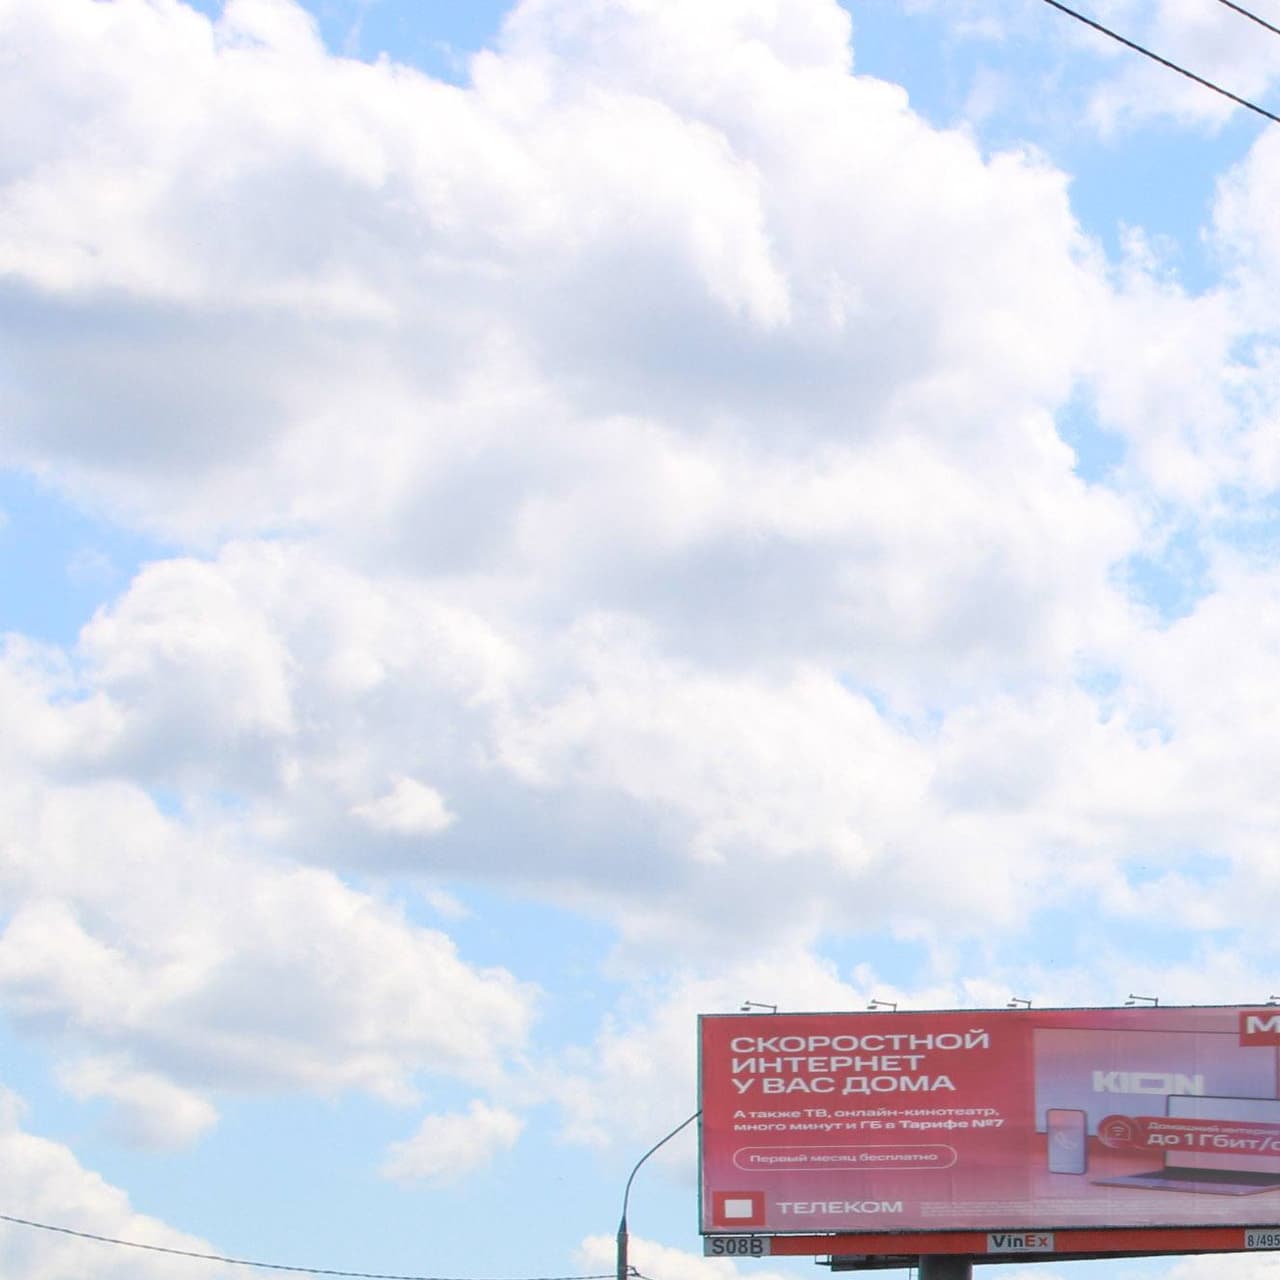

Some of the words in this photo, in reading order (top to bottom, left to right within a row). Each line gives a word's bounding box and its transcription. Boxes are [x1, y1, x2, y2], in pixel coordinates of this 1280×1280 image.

[729, 1028, 990, 1053] СКОРОСТНОЙ
[731, 1054, 926, 1074] ИНТЕРНЕТ
[731, 1077, 755, 1095] У
[762, 1076, 835, 1094] ВАС
[841, 1074, 957, 1096] ДОМА
[1092, 1070, 1206, 1096] KION
[733, 1109, 746, 1119] А
[748, 1109, 801, 1119] также
[803, 1108, 832, 1119] ТВ,
[733, 1122, 787, 1132] много
[789, 1121, 842, 1131] минут
[845, 1121, 857, 1130] и
[860, 1119, 882, 1130] ГБ
[885, 1121, 896, 1130] в
[898, 1117, 969, 1131] Тарифе
[971, 1117, 1005, 1129] №7
[1147, 1133, 1181, 1147] до
[1184, 1133, 1194, 1146] 1
[750, 1154, 809, 1165] Первый
[810, 1153, 857, 1164] месяц
[858, 1151, 939, 1163] бесплатно
[776, 1200, 903, 1215] ТЕЛЕКОМ
[711, 1238, 764, 1256] S08B
[991, 1234, 1048, 1249] VinEx
